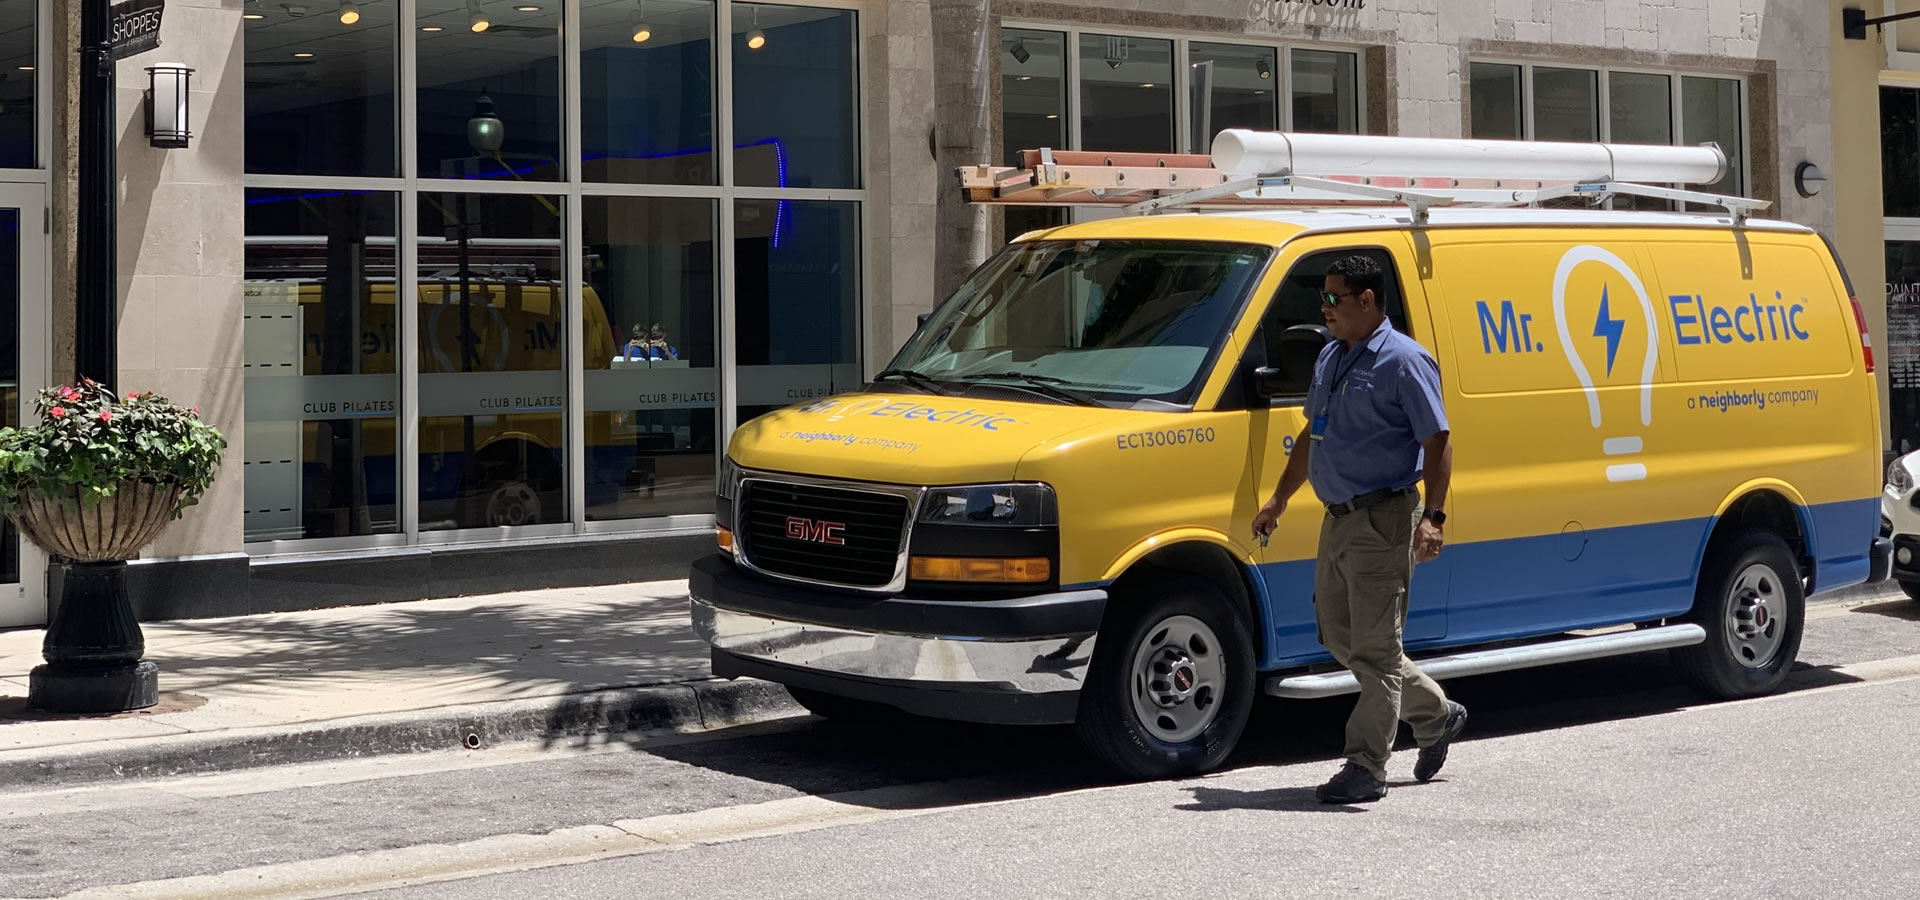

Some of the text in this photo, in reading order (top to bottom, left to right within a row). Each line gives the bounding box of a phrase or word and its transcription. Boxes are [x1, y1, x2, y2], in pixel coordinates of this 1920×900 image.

[112, 11, 160, 42] SHOPPES
[1475, 289, 1810, 354] Mr. Electric
[480, 396, 562, 408] CLUB PILATES
[639, 392, 716, 403] CLUB PILATES
[786, 388, 813, 398] CLUB
[1687, 388, 1818, 412] a neighborly company
[303, 401, 394, 413] CLUB PILATES
[870, 401, 1016, 431] Electric
[791, 431, 857, 446] neighborly
[859, 436, 922, 454] company
[1116, 427, 1216, 450] EC13006760
[785, 516, 846, 545] GMC
